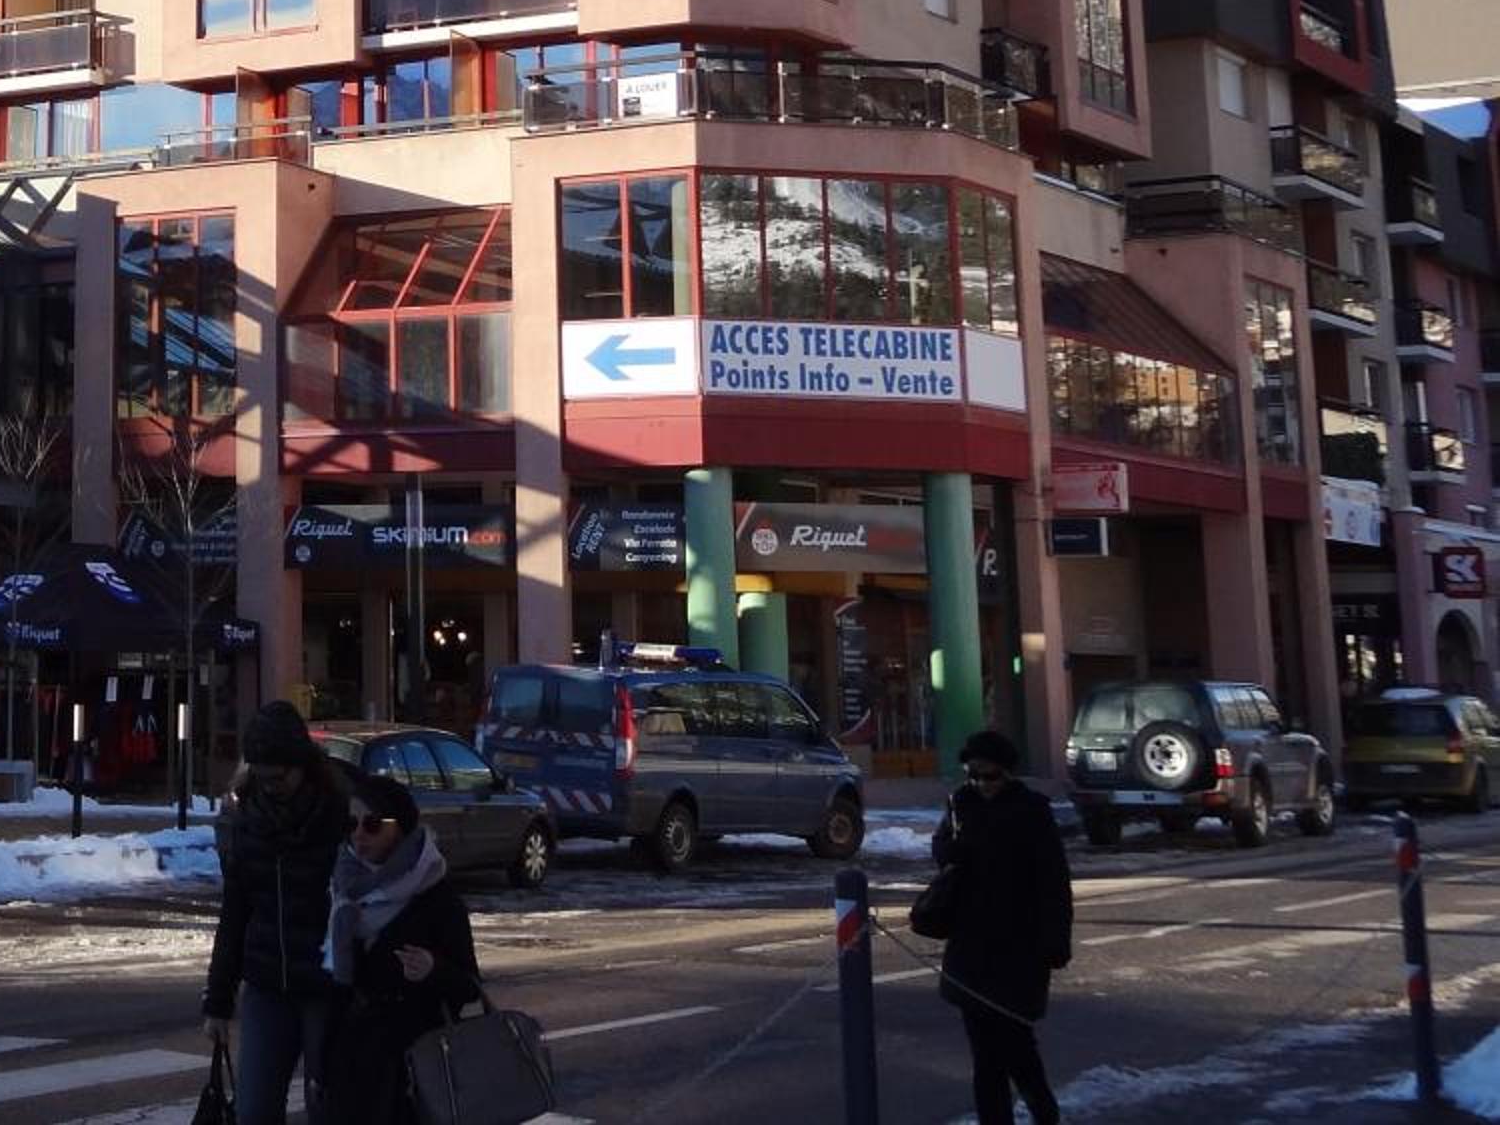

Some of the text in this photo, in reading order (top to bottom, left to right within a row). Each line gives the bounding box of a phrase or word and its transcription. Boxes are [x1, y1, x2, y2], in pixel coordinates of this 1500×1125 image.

[710, 324, 953, 362] ACCES TELECABINE
[710, 360, 790, 391] Points
[799, 362, 850, 392] Info
[882, 365, 955, 395] Vente
[292, 519, 353, 539] Riquet
[790, 525, 868, 551] Riquet
